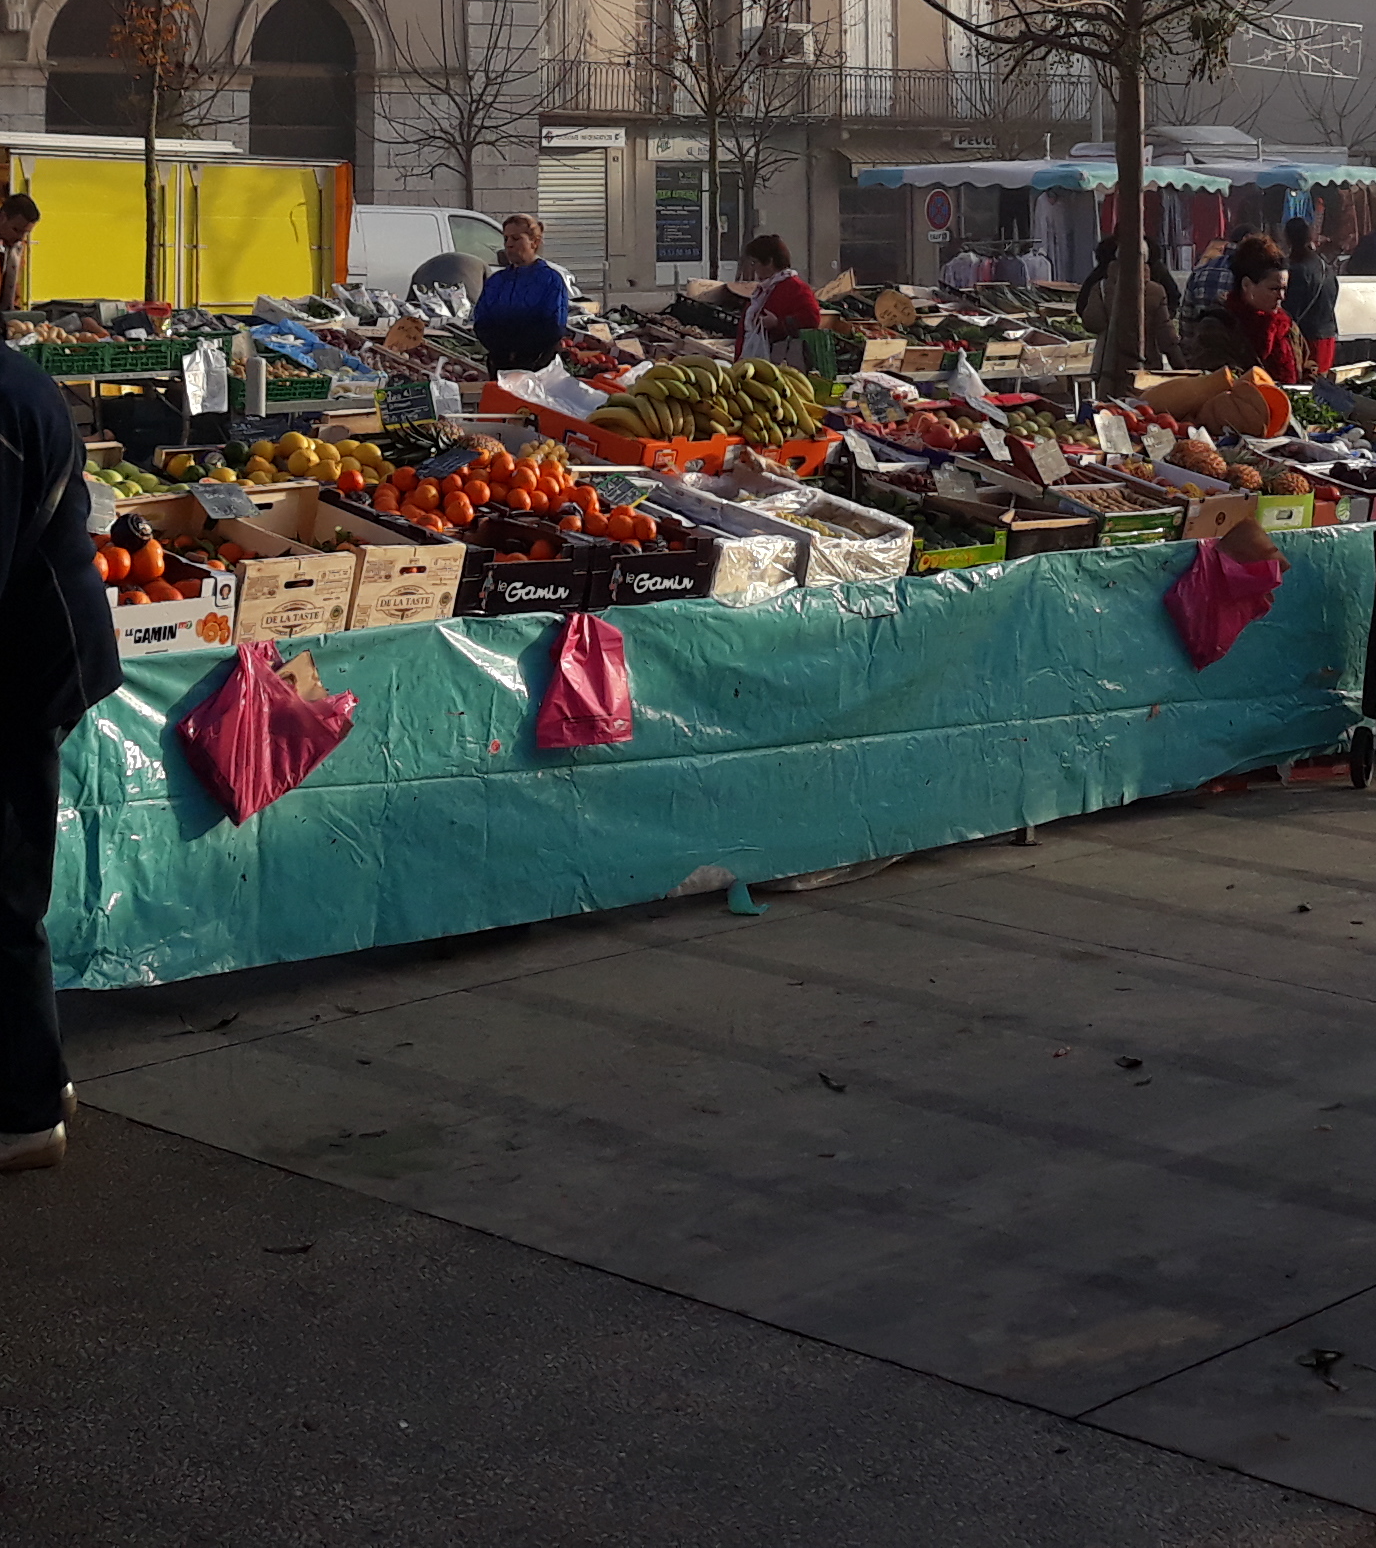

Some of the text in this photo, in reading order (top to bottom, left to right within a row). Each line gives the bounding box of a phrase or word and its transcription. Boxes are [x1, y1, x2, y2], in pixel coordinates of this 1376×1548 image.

[497, 580, 570, 602] le Gamin
[626, 572, 694, 594] le Gamin
[380, 596, 431, 608] DE LA TASTE
[265, 610, 320, 624] DE LA TASTE
[125, 629, 133, 637] LE
[133, 624, 178, 644] GAMIN
